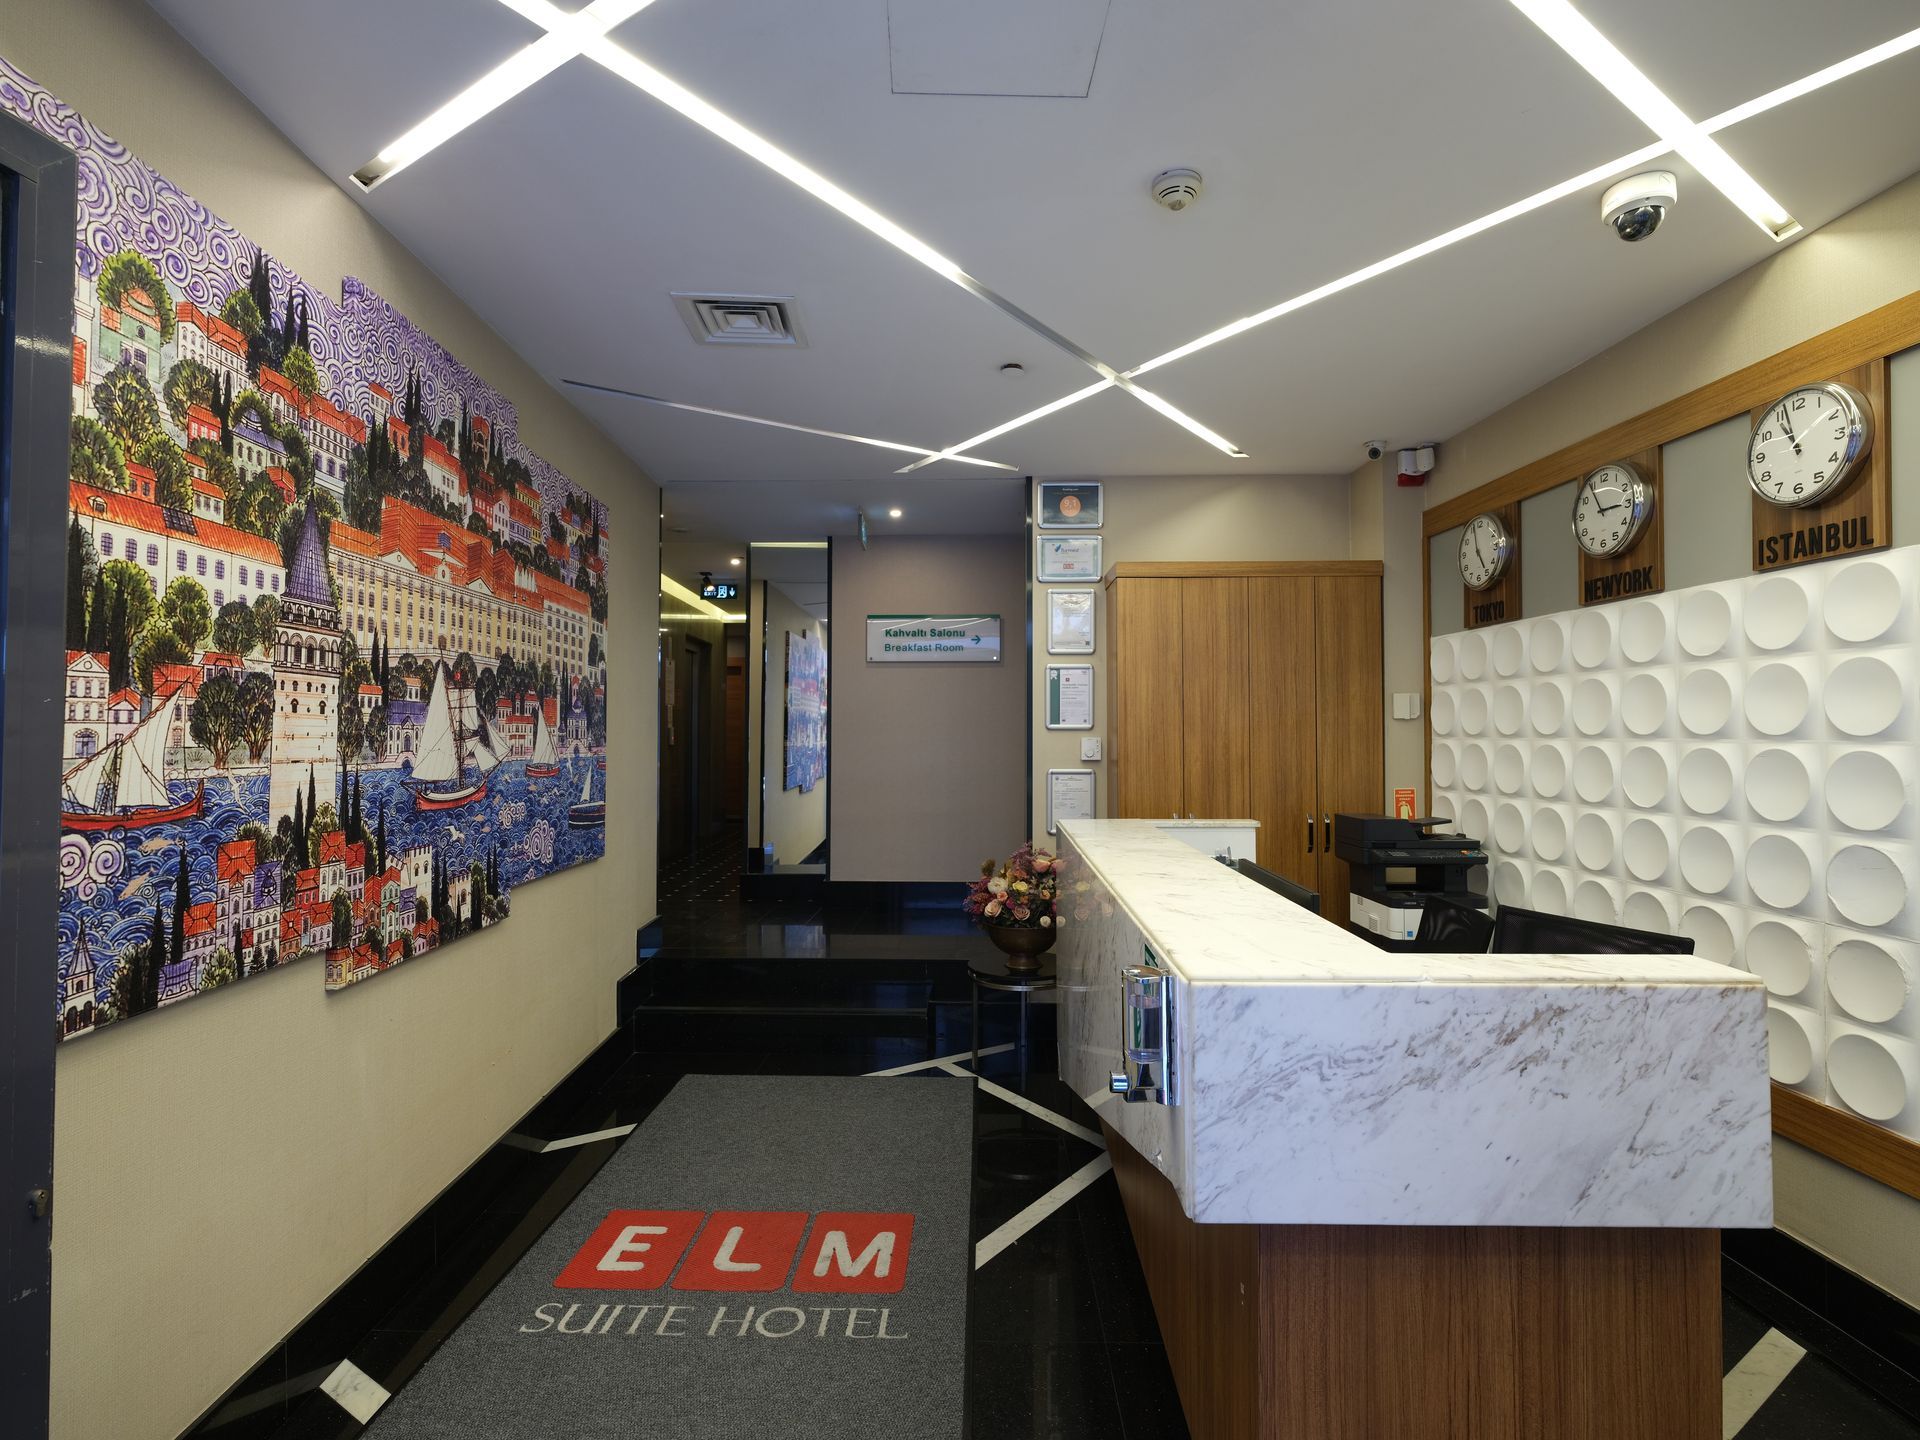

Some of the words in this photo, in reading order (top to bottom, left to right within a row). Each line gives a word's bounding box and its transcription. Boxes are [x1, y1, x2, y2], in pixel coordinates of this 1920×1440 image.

[1792, 398, 1806, 411] 12
[1817, 397, 1821, 408] 1
[1776, 410, 1784, 422] 11
[1828, 409, 1839, 421] 2
[1762, 431, 1772, 442] 10
[1834, 427, 1846, 440] 3
[1756, 453, 1765, 463] 9
[1828, 451, 1839, 463] 4
[1600, 473, 1609, 483] 12
[1615, 474, 1618, 482] 1
[1761, 471, 1772, 482] 8
[1813, 471, 1825, 483] 5
[1621, 483, 1628, 492] 2
[1775, 482, 1784, 494] 7
[1793, 483, 1804, 494] 6
[1582, 497, 1589, 505] 10
[1624, 499, 1631, 508] 3
[1579, 513, 1585, 522] 9
[1621, 517, 1628, 526] 4
[1581, 528, 1588, 536] 8
[1612, 532, 1619, 540] 5
[1589, 538, 1595, 546] 7
[1600, 539, 1606, 548] 6
[1758, 516, 1875, 566] ISTANBUL
[1584, 565, 1653, 603] NEWYORK
[1473, 600, 1505, 624] TOKYO
[885, 628, 927, 638] Kahvaltı
[930, 628, 966, 638] Salonu
[884, 643, 932, 652] Breakfast
[935, 643, 964, 652] Room
[596, 1225, 896, 1278] ELM
[519, 1302, 698, 1337] SUITE
[707, 1306, 909, 1339] HOTEL
